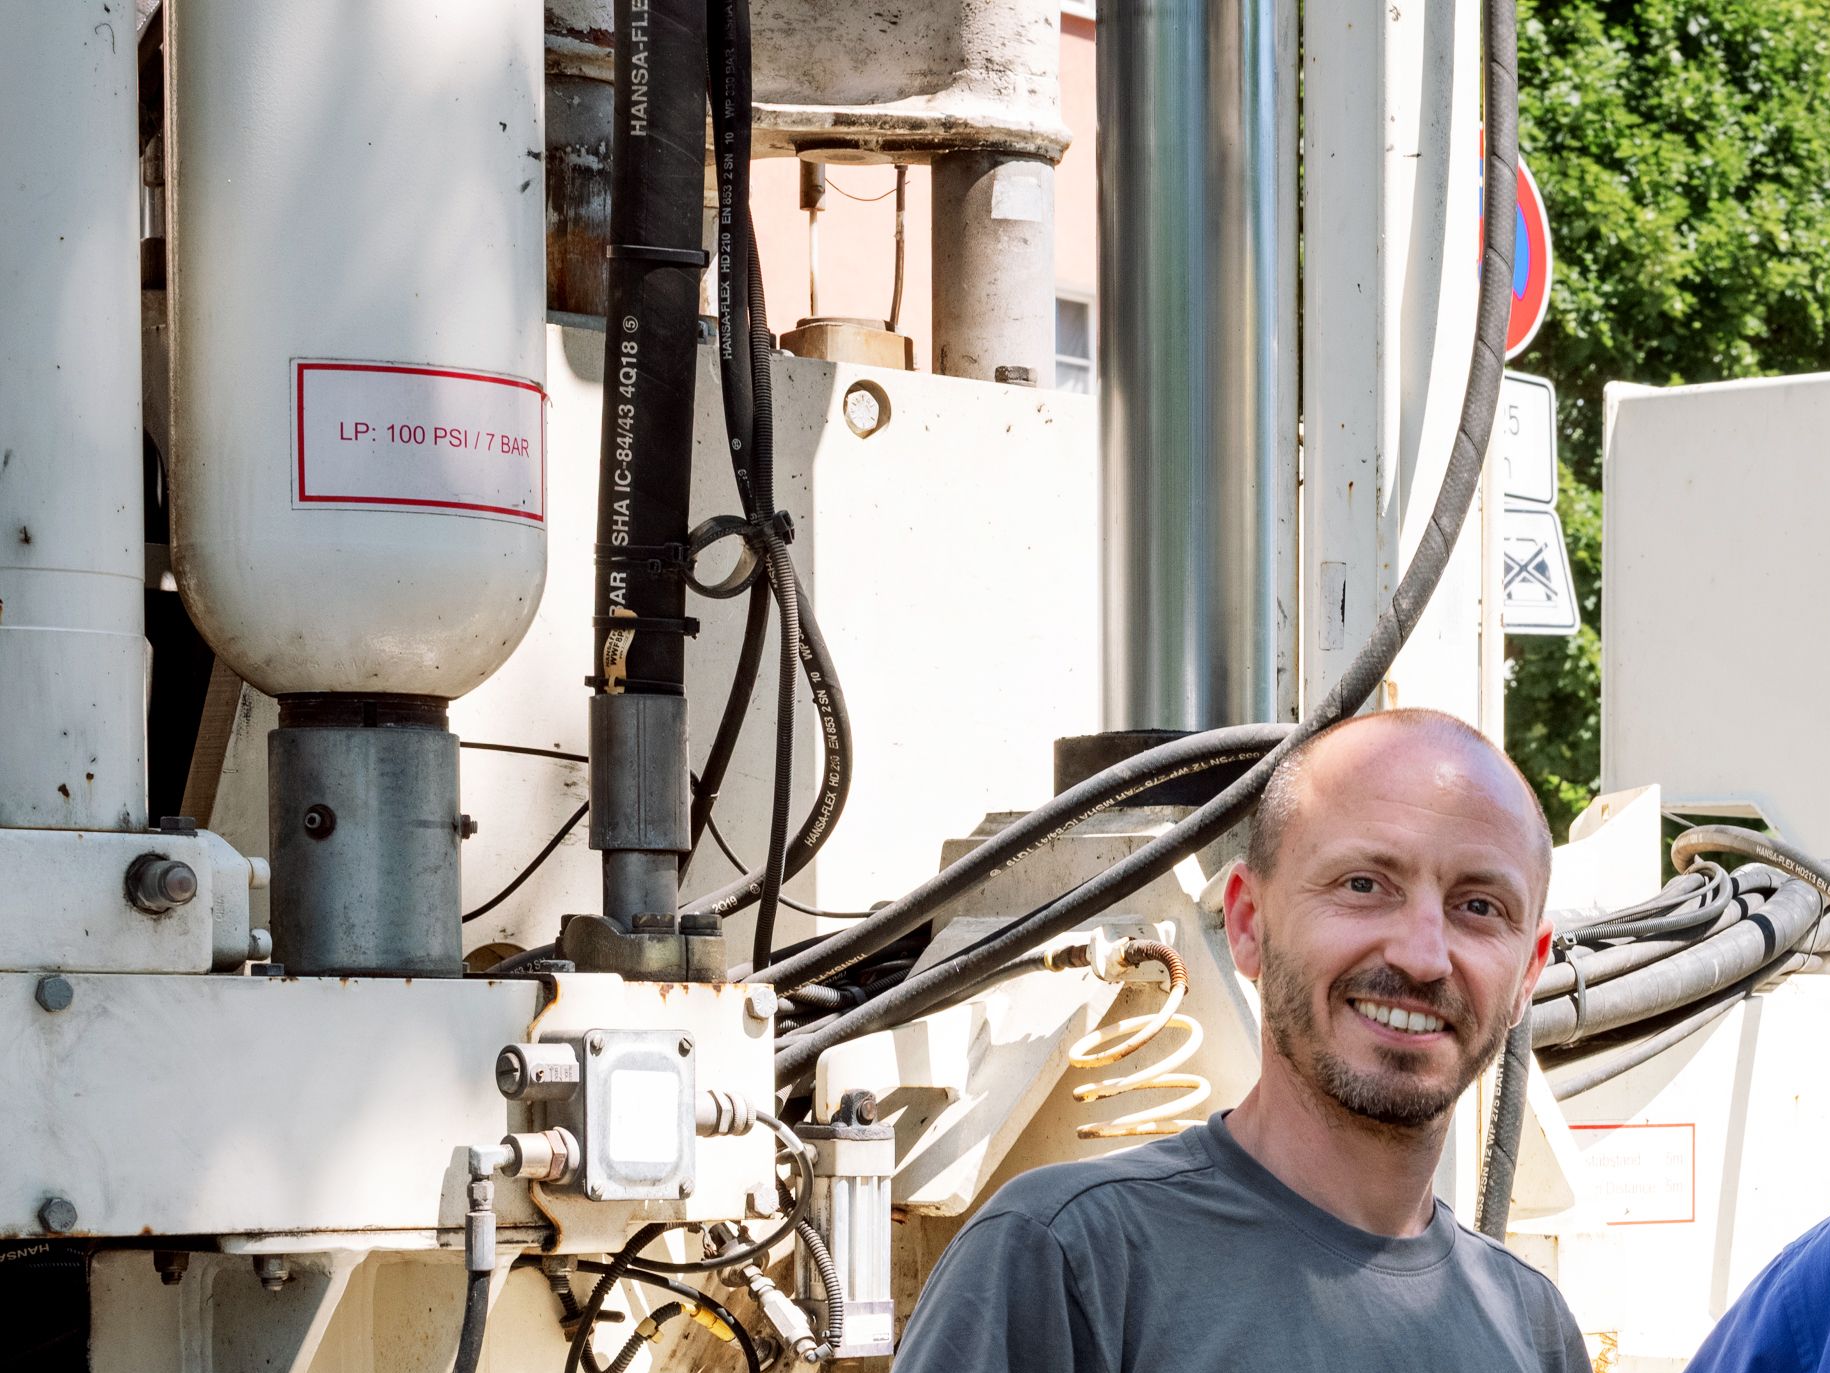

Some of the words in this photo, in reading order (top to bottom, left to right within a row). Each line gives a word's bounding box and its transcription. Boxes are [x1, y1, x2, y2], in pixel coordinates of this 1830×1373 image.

[725, 47, 736, 76] BAR
[724, 98, 736, 119] WP
[724, 131, 735, 145] 10
[722, 184, 733, 205] 853
[722, 207, 732, 225] EN
[721, 232, 731, 253] 210
[721, 255, 731, 273] HD
[721, 280, 733, 360] HANSA-FLEX
[619, 340, 638, 399] 4Q18
[339, 421, 377, 442] LP:
[386, 424, 426, 445] 100
[434, 426, 468, 448] PSI
[474, 431, 480, 450] /
[486, 433, 496, 451] 7
[501, 436, 530, 458] BAR
[614, 404, 635, 492] IC-84/43
[612, 499, 630, 561] SHA
[810, 671, 822, 683] 10
[825, 717, 837, 734] 853
[828, 736, 840, 750] EN
[828, 771, 840, 787] HD
[804, 791, 837, 847] HANSA-FLEX
[1079, 798, 1115, 821] MSHA
[1756, 844, 1796, 872] HANSA-FLEX
[1795, 864, 1817, 884] HD213
[1816, 879, 1827, 892] EN
[712, 895, 739, 914] 2Q19
[1494, 1067, 1506, 1098] BAR
[1491, 1101, 1500, 1123] 275
[1486, 1123, 1497, 1146] WP
[1484, 1148, 1493, 1167] 12
[1476, 1196, 1486, 1218] 853
